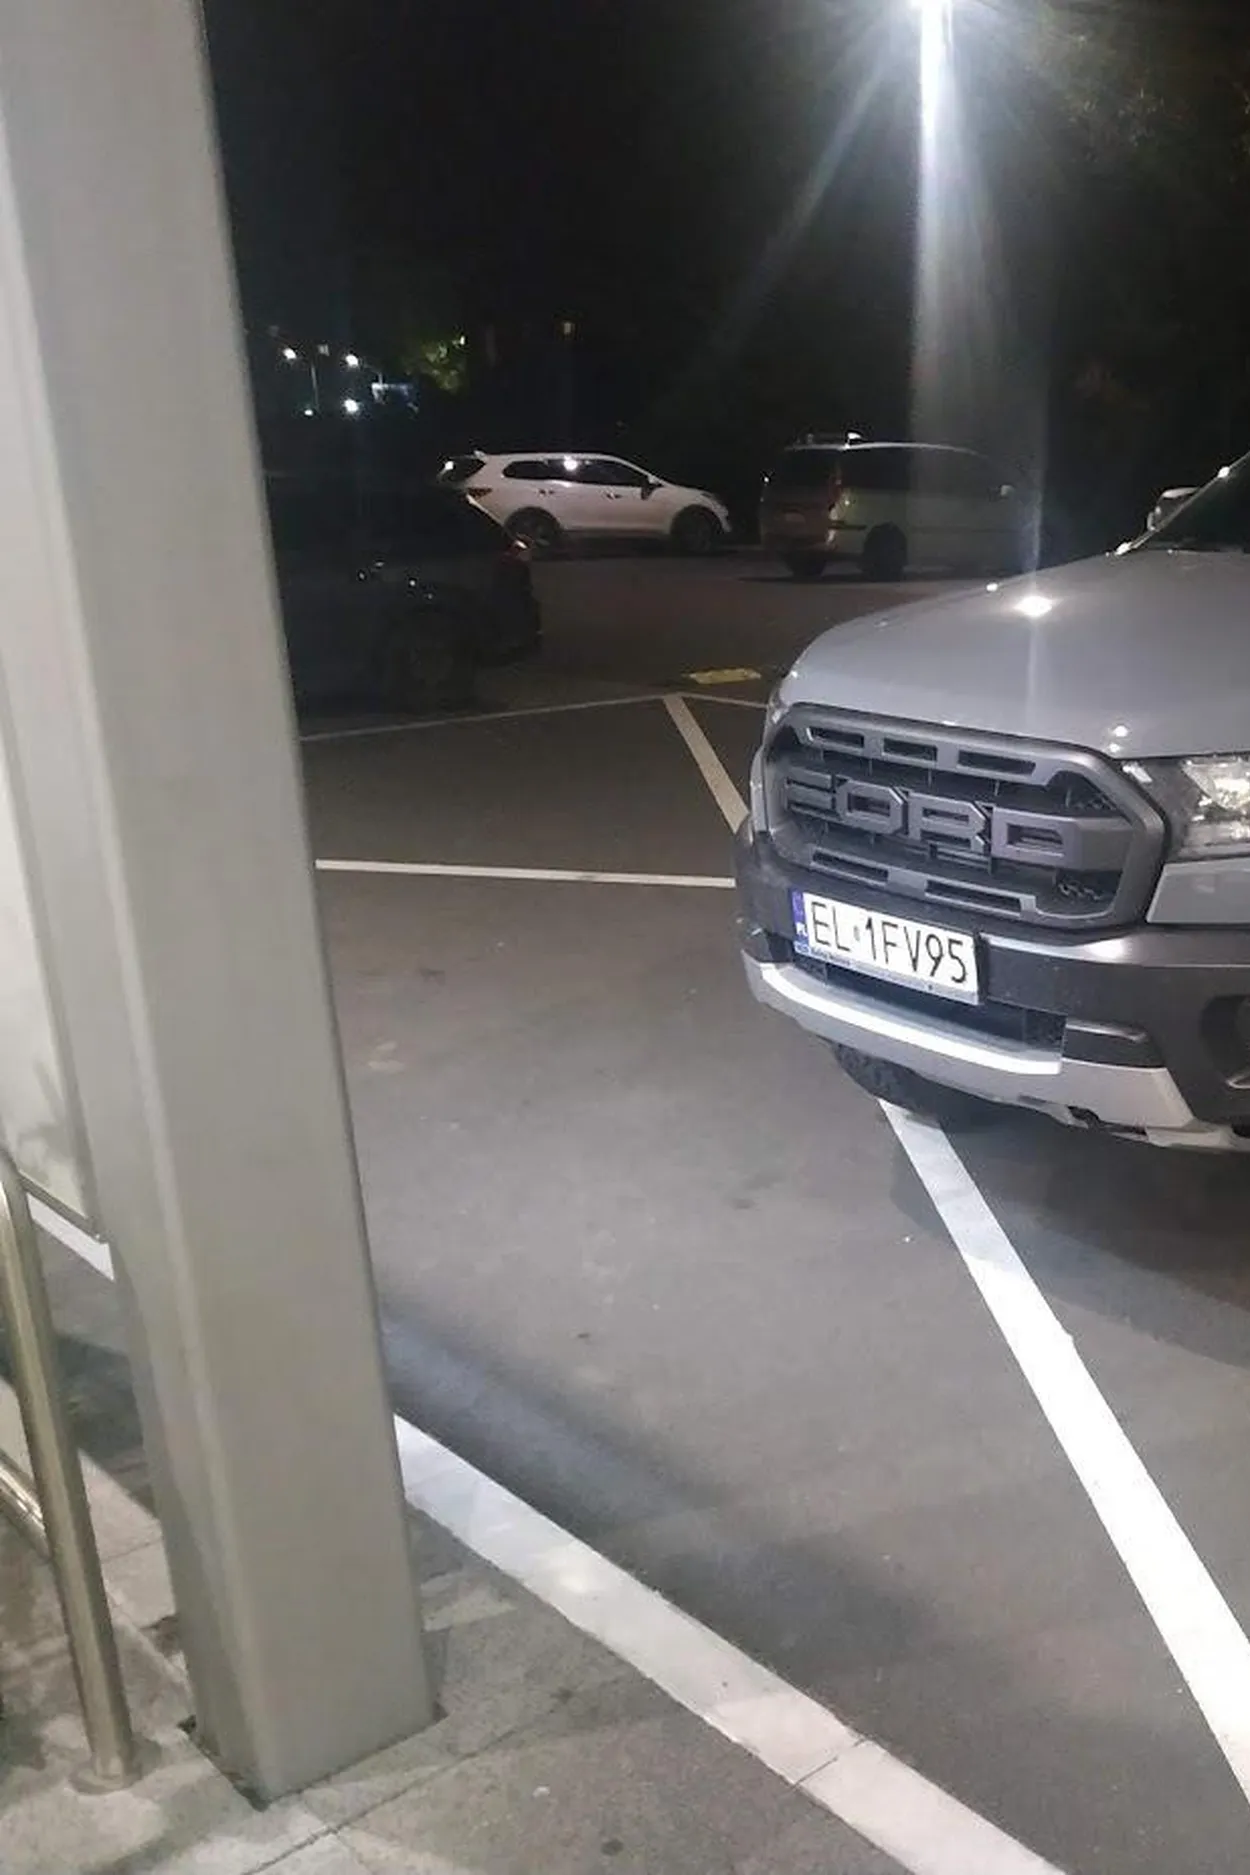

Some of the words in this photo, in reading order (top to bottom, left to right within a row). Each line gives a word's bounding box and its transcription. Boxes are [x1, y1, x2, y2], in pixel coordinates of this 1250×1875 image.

[785, 767, 1080, 871] FORD
[811, 901, 850, 952] EL
[865, 916, 968, 984] 1FV95
